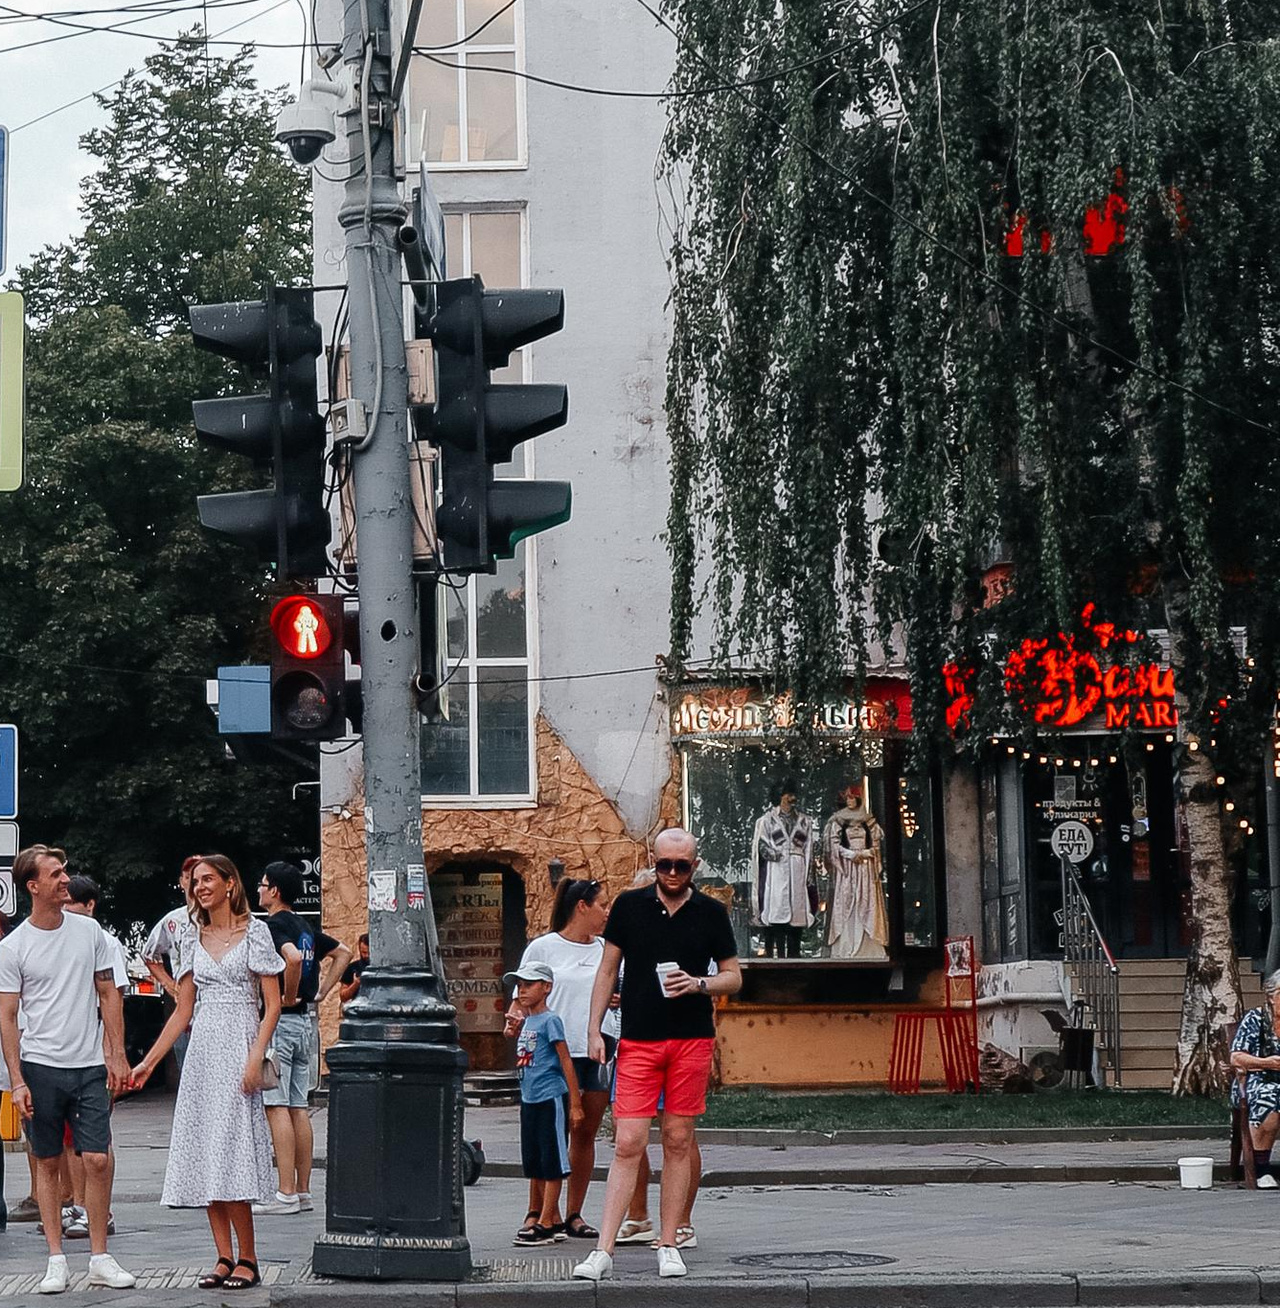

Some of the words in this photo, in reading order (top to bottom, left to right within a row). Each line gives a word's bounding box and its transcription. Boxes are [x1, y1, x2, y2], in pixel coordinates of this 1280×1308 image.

[1042, 800, 1091, 809] продукты
[1094, 798, 1100, 807] &
[1043, 811, 1097, 821] кулинария
[1058, 829, 1086, 841] ЕДА
[1058, 842, 1088, 855] ТУТ!
[447, 979, 503, 993] ОМБА
